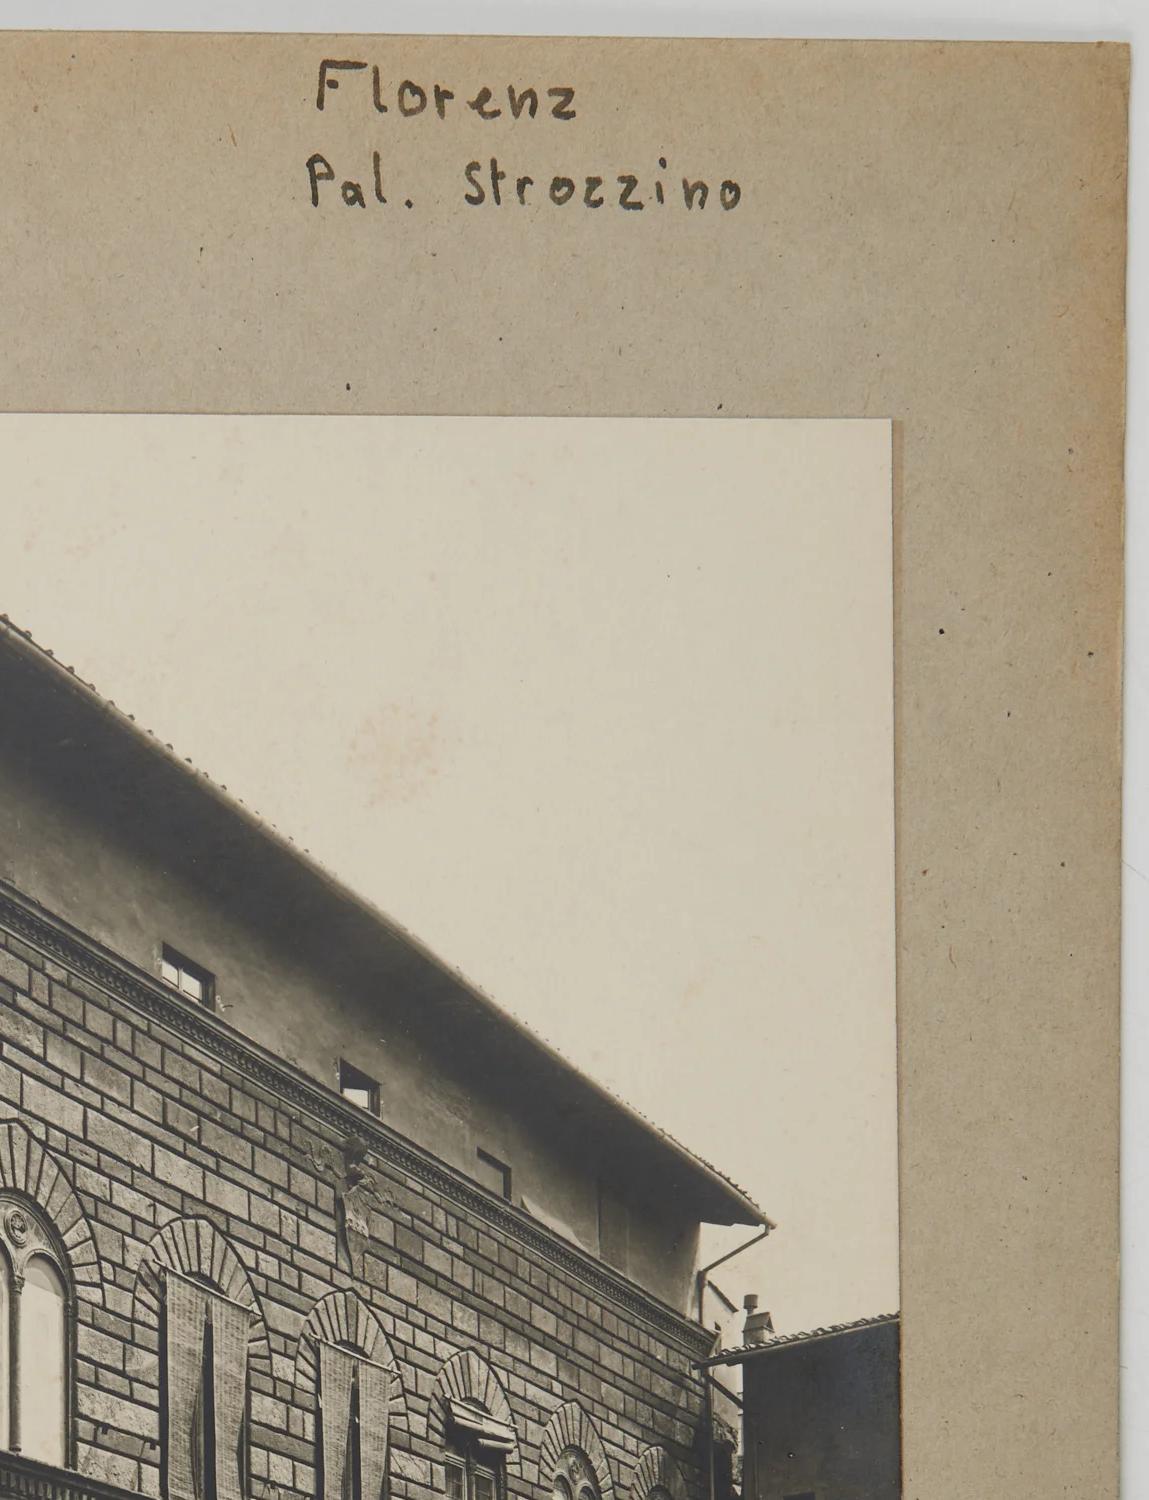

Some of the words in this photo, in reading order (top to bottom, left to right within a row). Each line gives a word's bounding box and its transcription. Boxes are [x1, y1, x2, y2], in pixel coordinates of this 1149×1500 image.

[317, 59, 577, 120] Florenz
[306, 151, 414, 209] Pal.
[464, 156, 742, 211] Strozzino
